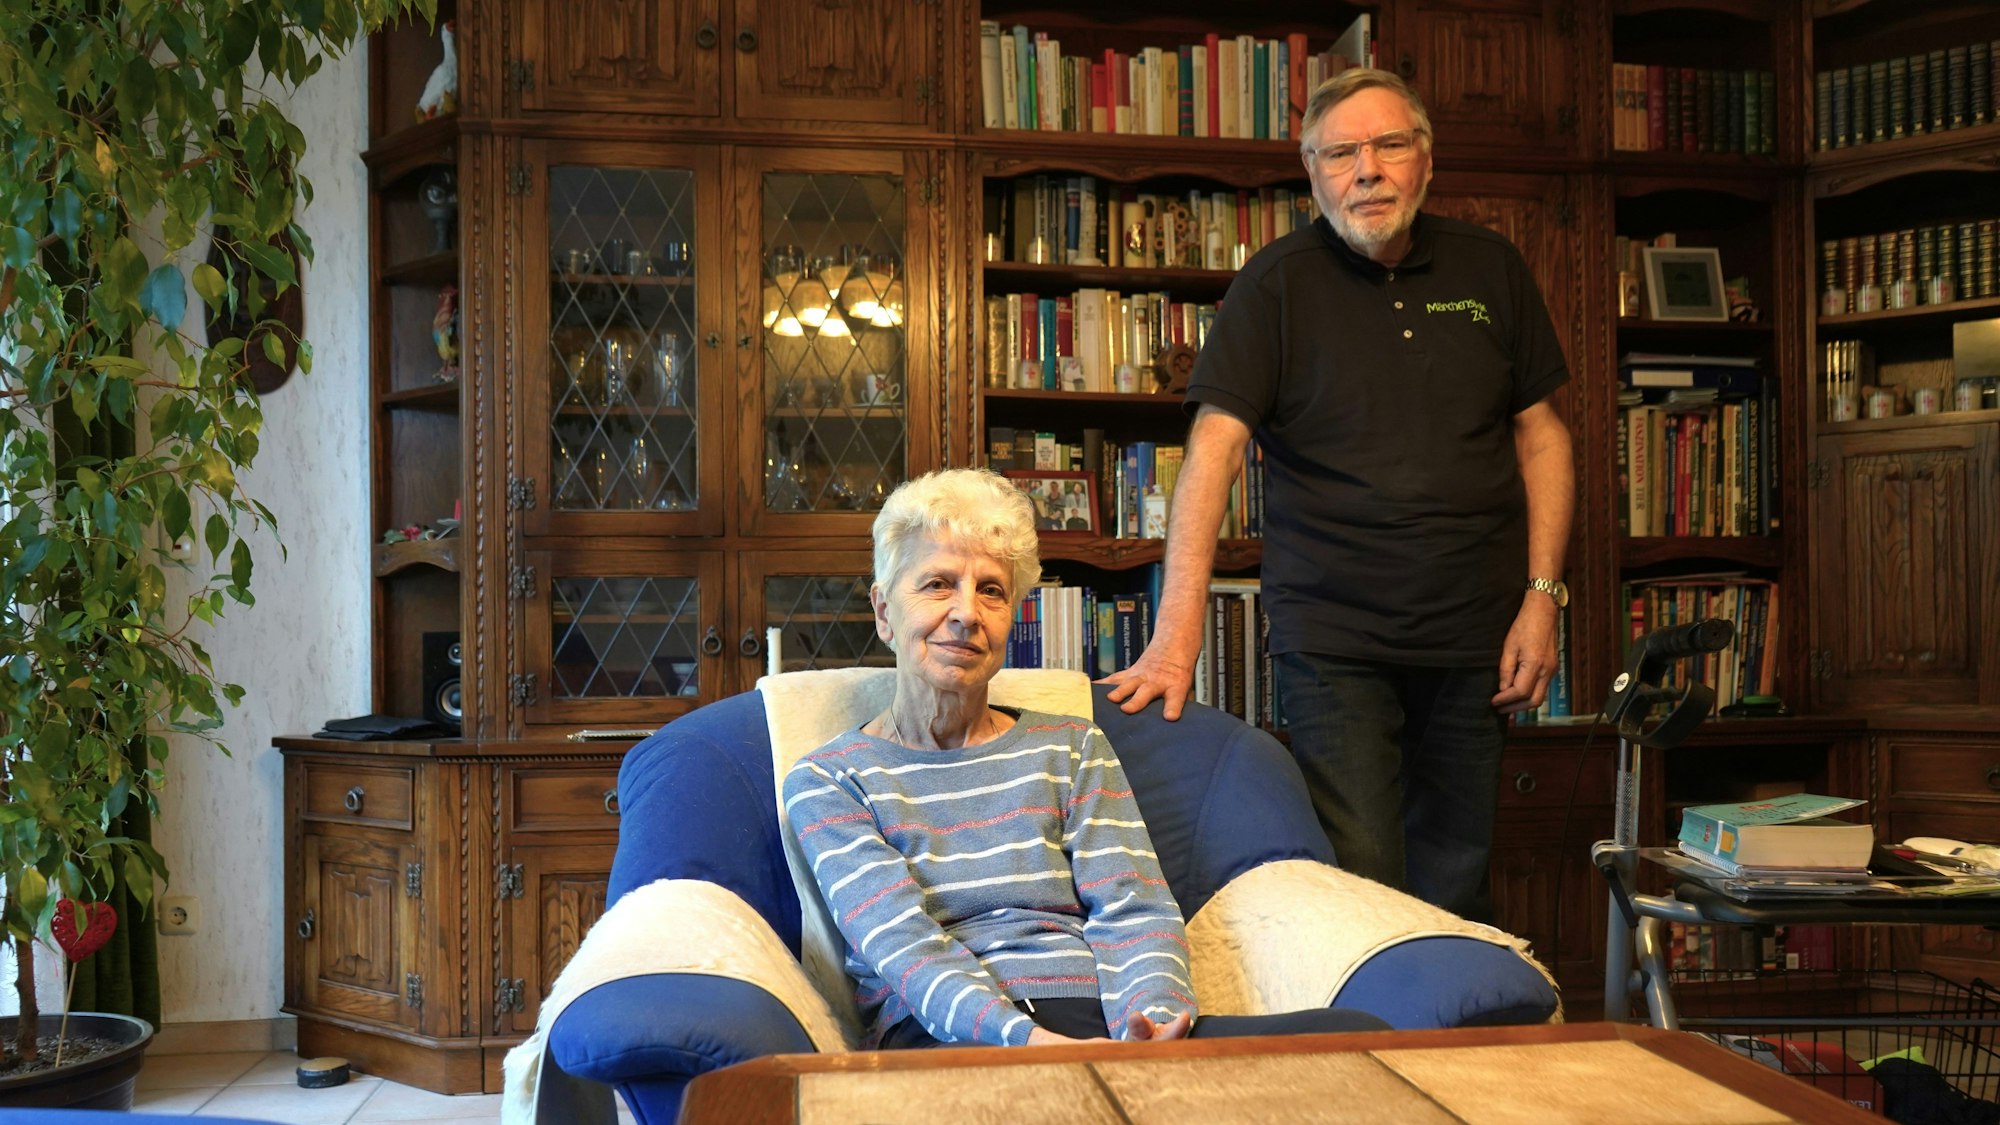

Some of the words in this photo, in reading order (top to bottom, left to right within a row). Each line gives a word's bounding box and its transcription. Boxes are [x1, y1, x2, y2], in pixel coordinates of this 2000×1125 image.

[1635, 416, 1645, 484] FASZINATION
[1635, 487, 1645, 511] TIER
[1217, 597, 1225, 612] AUF
[1217, 629, 1225, 658] SPUREN
[1124, 648, 1132, 669] Europa
[1217, 659, 1225, 673] DER
[1217, 674, 1225, 712] ENTDECKE
